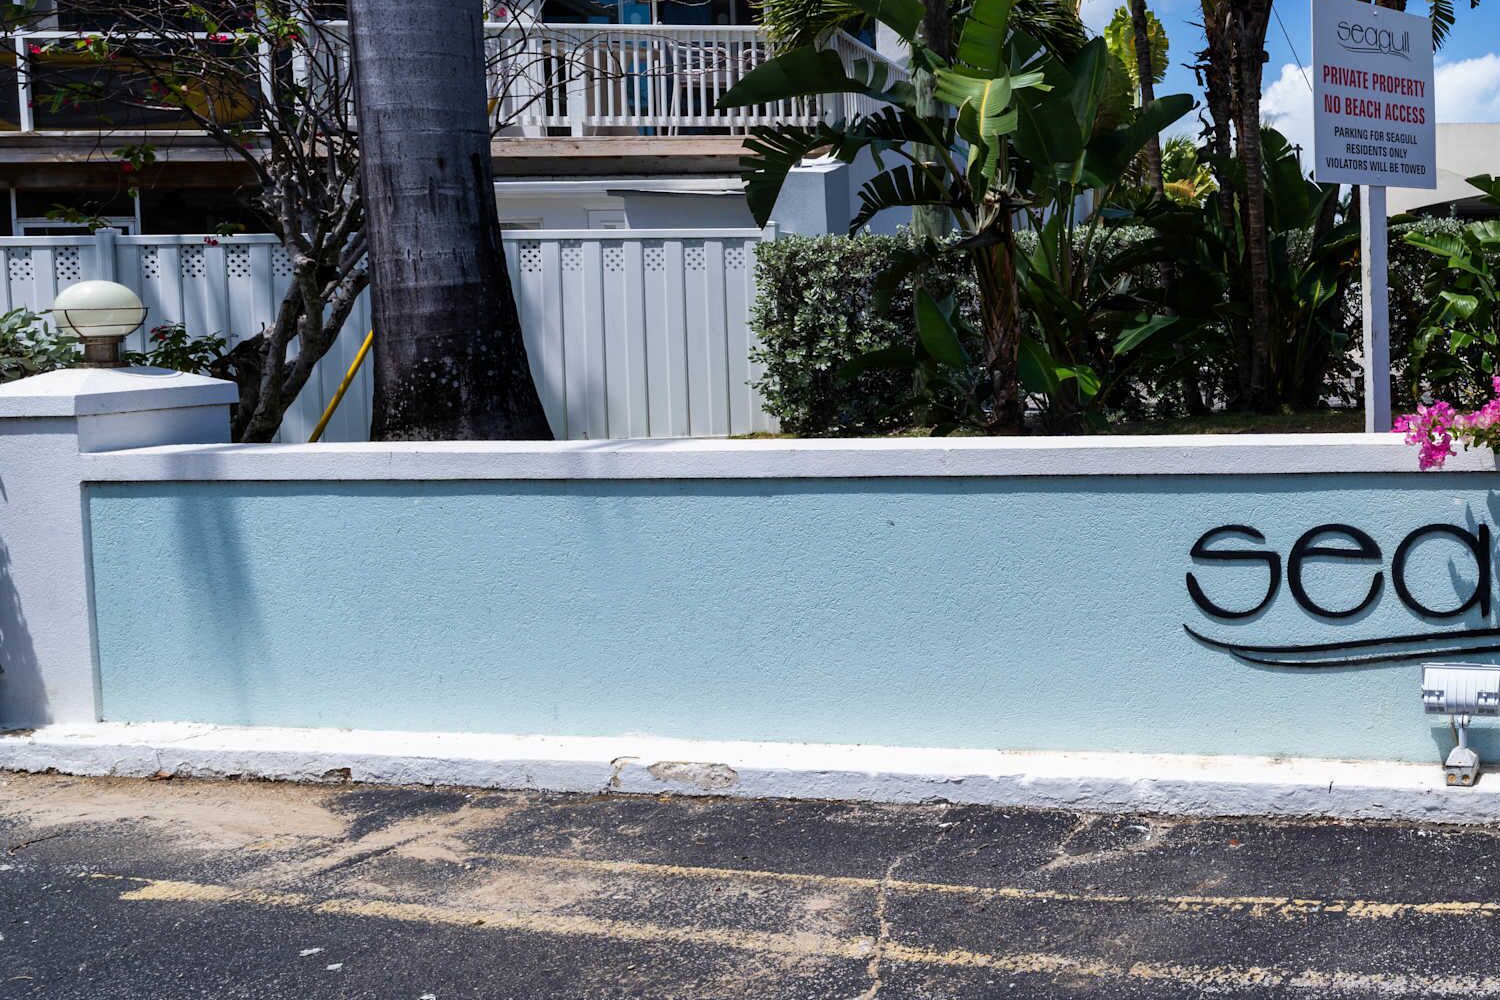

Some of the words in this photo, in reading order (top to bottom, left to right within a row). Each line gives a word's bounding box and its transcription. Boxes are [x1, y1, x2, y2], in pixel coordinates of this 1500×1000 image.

[1336, 21, 1410, 54] seagull
[1323, 65, 1368, 90] PRIVATE
[1372, 73, 1425, 97] PROPERTY
[1325, 94, 1341, 114] NO
[1345, 99, 1381, 119] BEACH
[1385, 104, 1425, 125] ACCESS
[1334, 126, 1368, 140] PARKING
[1370, 131, 1385, 142] FOR
[1386, 132, 1418, 145] SEAGULL
[1346, 143, 1387, 157] RESIDENTS
[1389, 148, 1408, 159] ONLY
[1326, 157, 1368, 171] VIOLATORS
[1370, 162, 1388, 172] WILL
[1389, 164, 1399, 173] BE
[1400, 164, 1426, 175] TOWED
